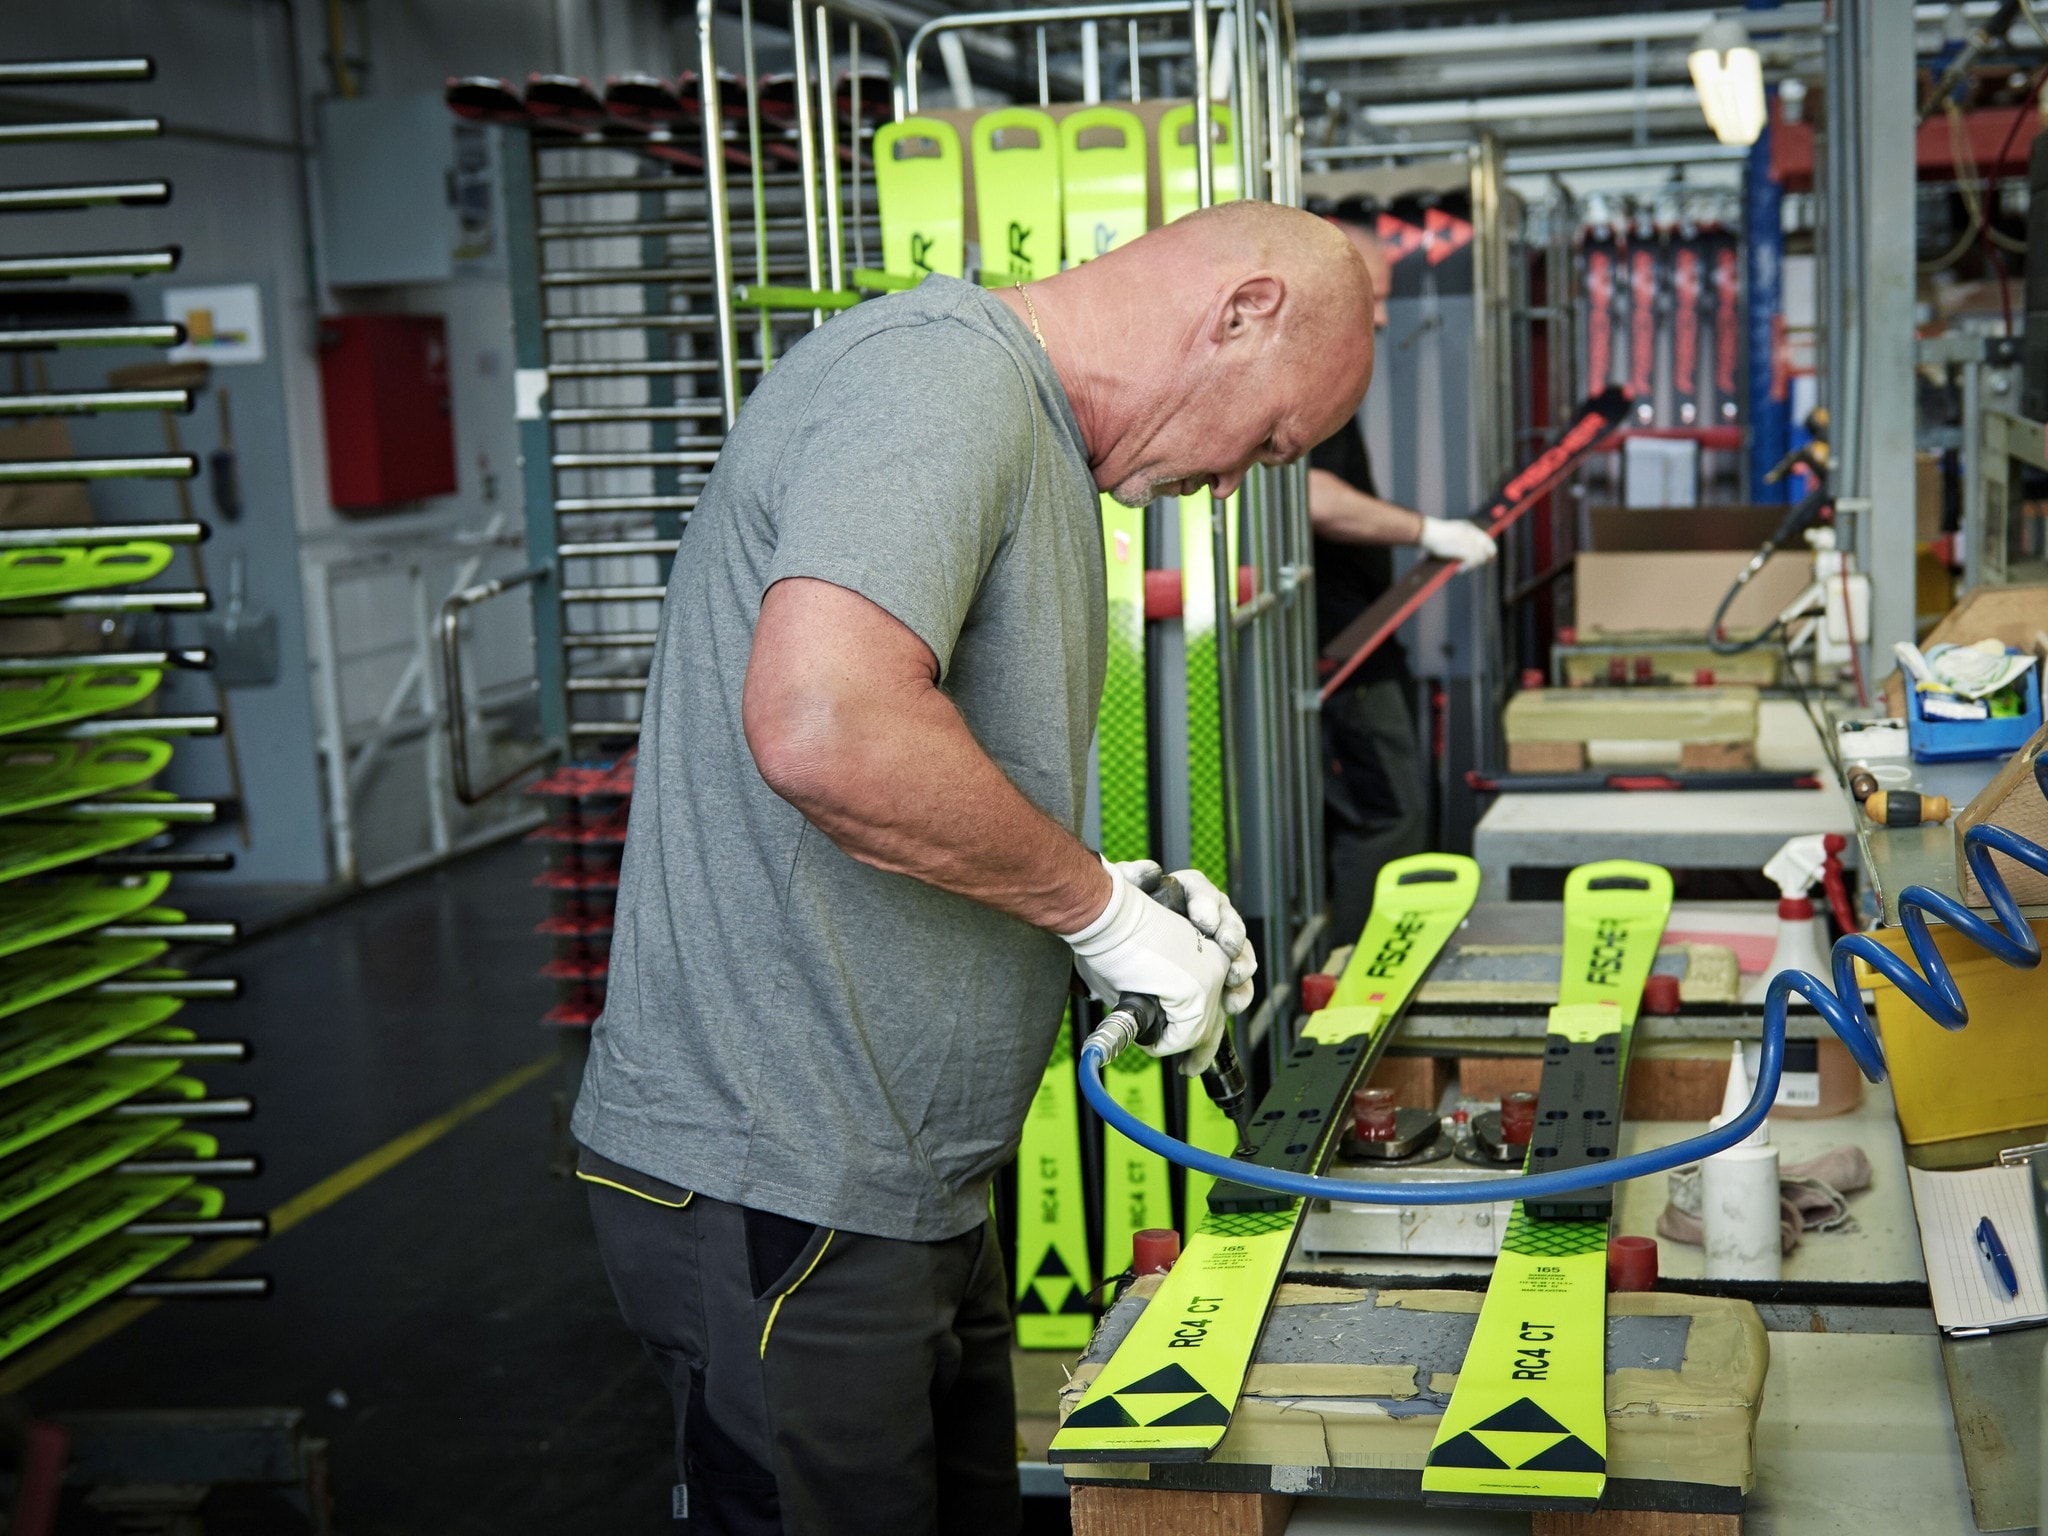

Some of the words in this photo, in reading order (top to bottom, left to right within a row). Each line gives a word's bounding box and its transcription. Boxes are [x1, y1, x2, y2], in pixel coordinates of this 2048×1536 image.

[1187, 1296, 1223, 1313] CT
[1168, 1319, 1212, 1348] RC4
[1519, 1322, 1555, 1341] CT
[1512, 1349, 1551, 1380] RC4
